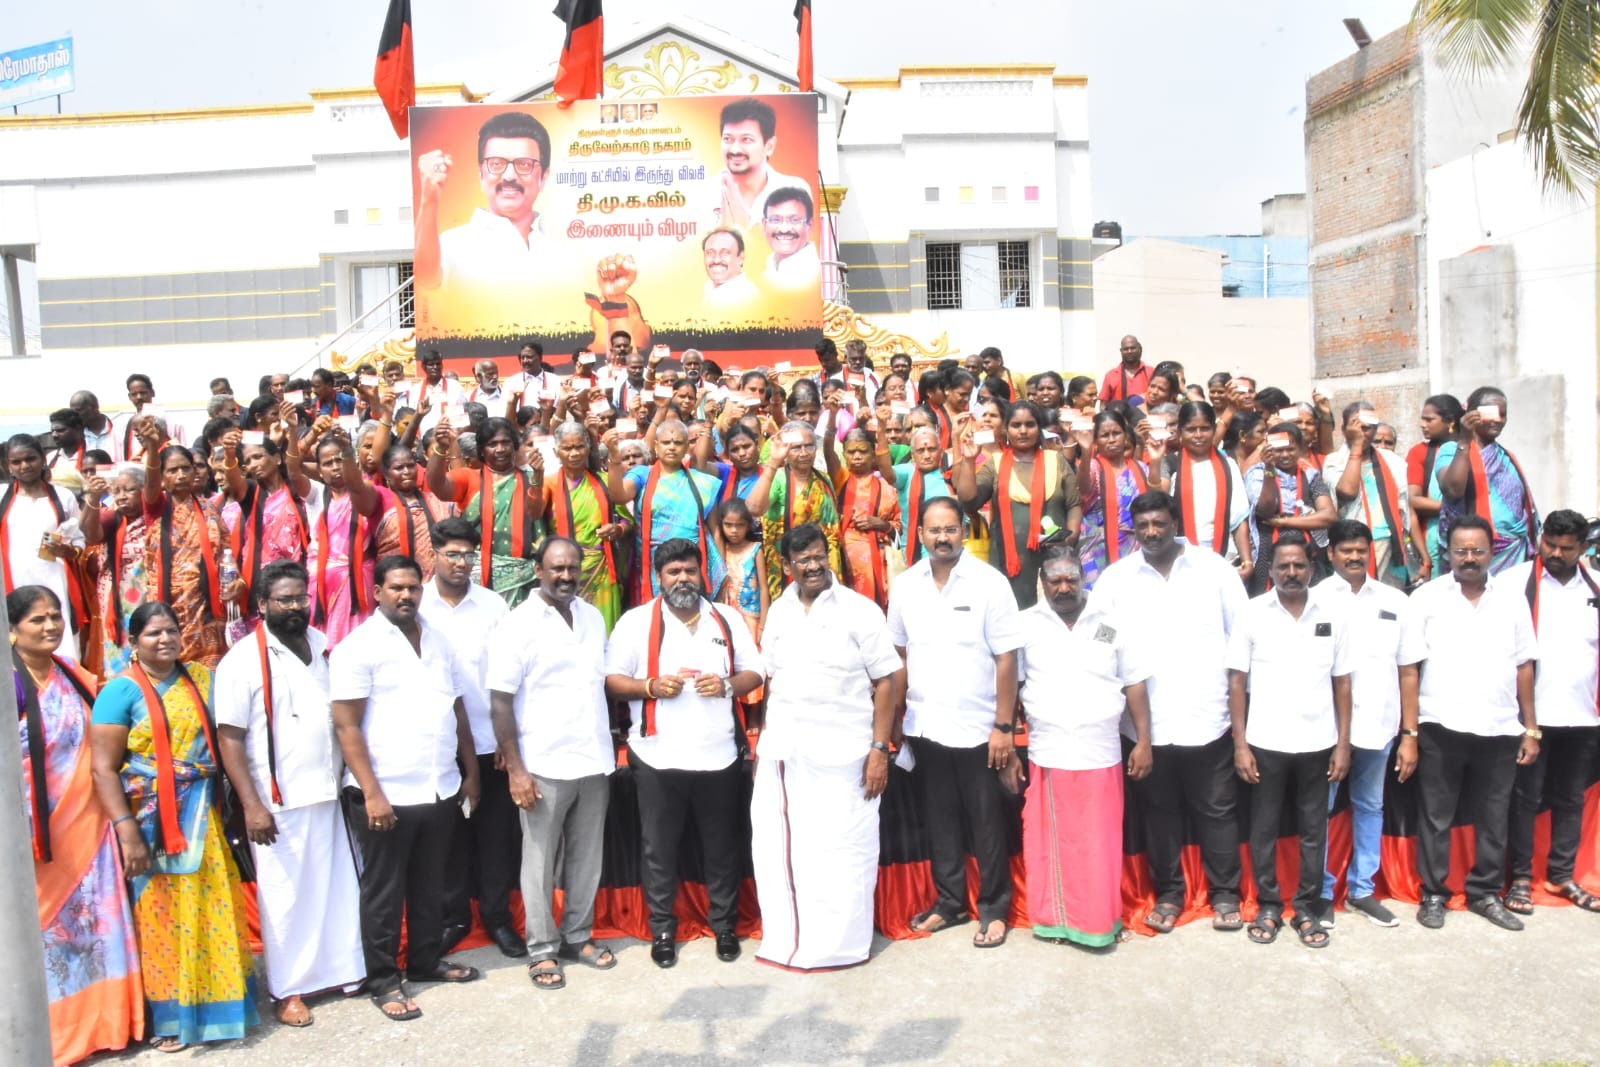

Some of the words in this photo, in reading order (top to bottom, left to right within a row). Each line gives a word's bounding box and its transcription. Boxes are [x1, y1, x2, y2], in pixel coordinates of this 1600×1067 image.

[568, 140, 650, 157] திருவேற்காடு
[653, 138, 692, 155] நகரம்
[556, 169, 587, 188] மாற்று
[591, 167, 631, 183] கட்சியில்
[634, 165, 674, 186] இருந்து
[678, 165, 705, 181] விலகி
[576, 190, 687, 214] தி.மு.க.வில்
[567, 218, 654, 242] இணையும்
[657, 217, 698, 242] விழா
